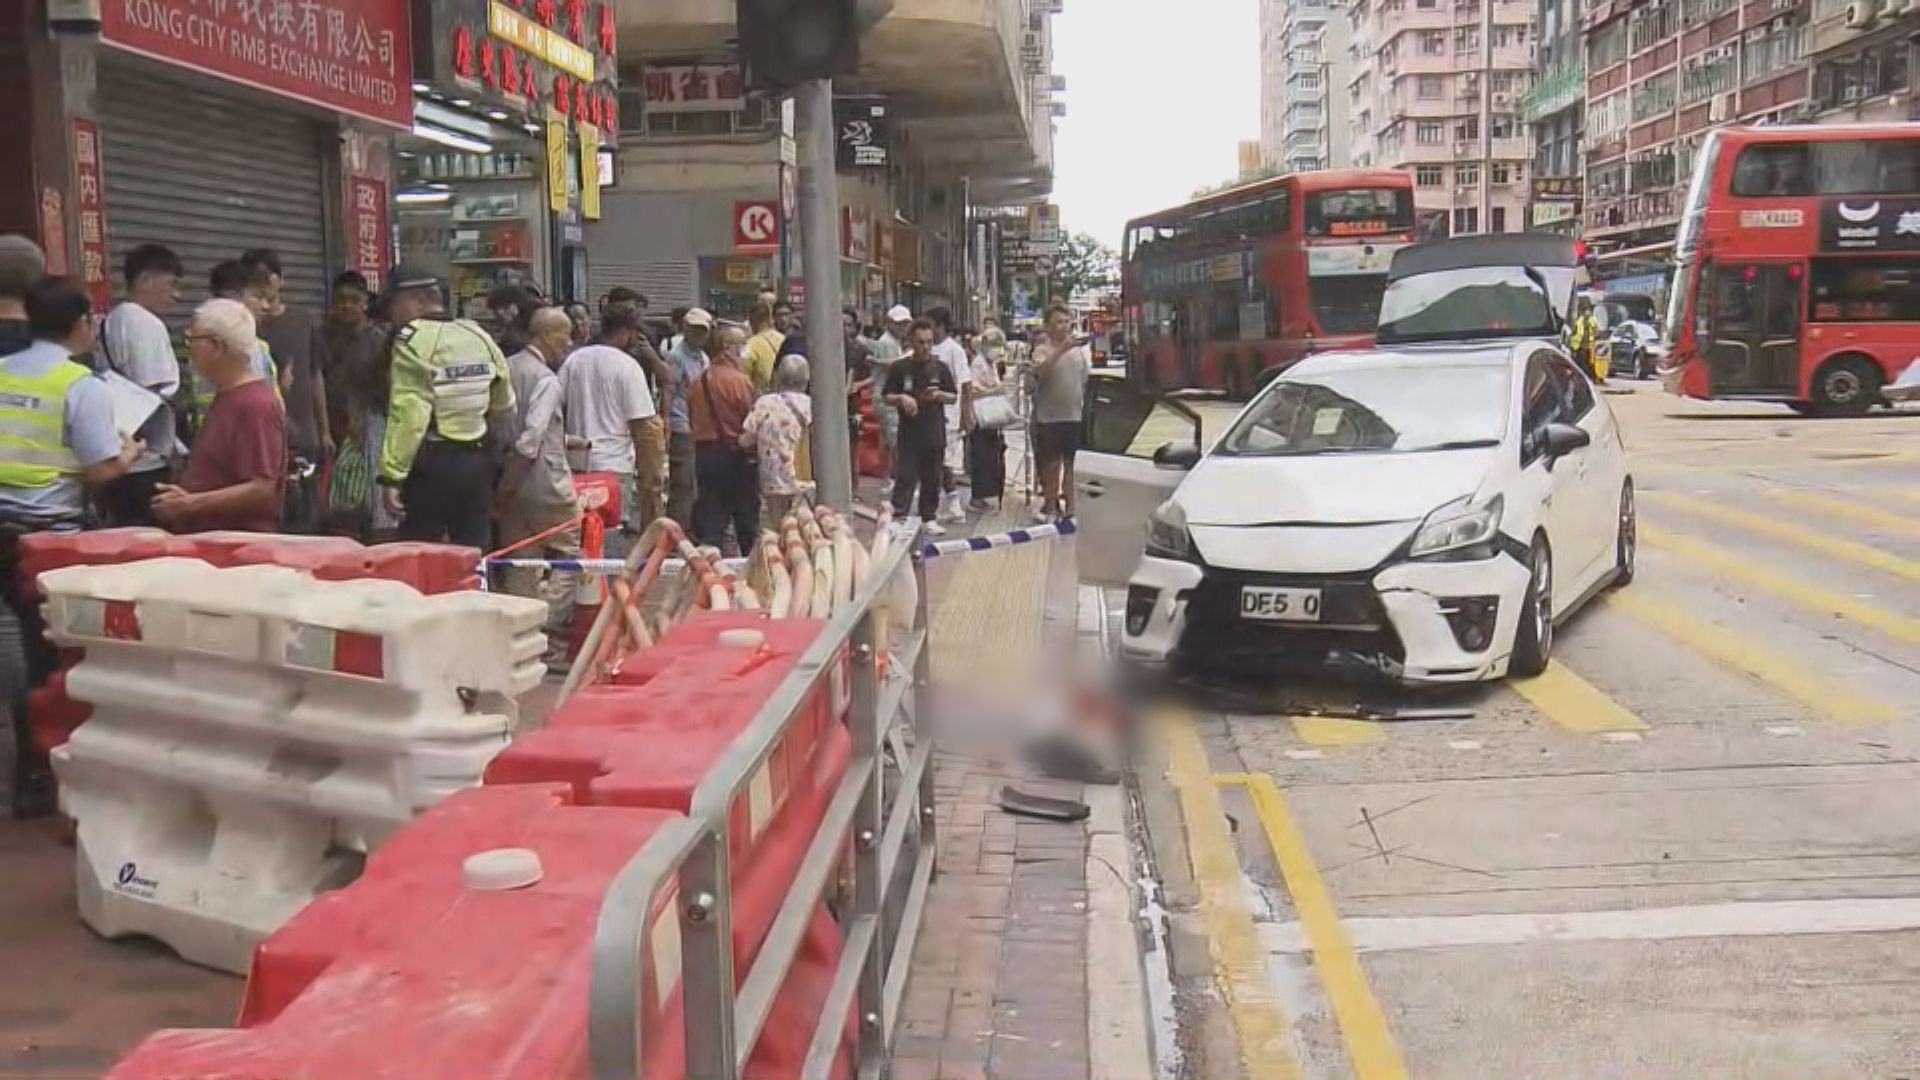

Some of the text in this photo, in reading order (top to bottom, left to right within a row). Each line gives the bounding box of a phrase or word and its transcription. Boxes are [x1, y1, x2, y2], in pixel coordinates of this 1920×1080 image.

[124, 0, 397, 106] KONG CITY RMB EXCHANGE LIMITED
[190, 0, 395, 77] 找換有限公司
[76, 130, 104, 283] 國內匯款
